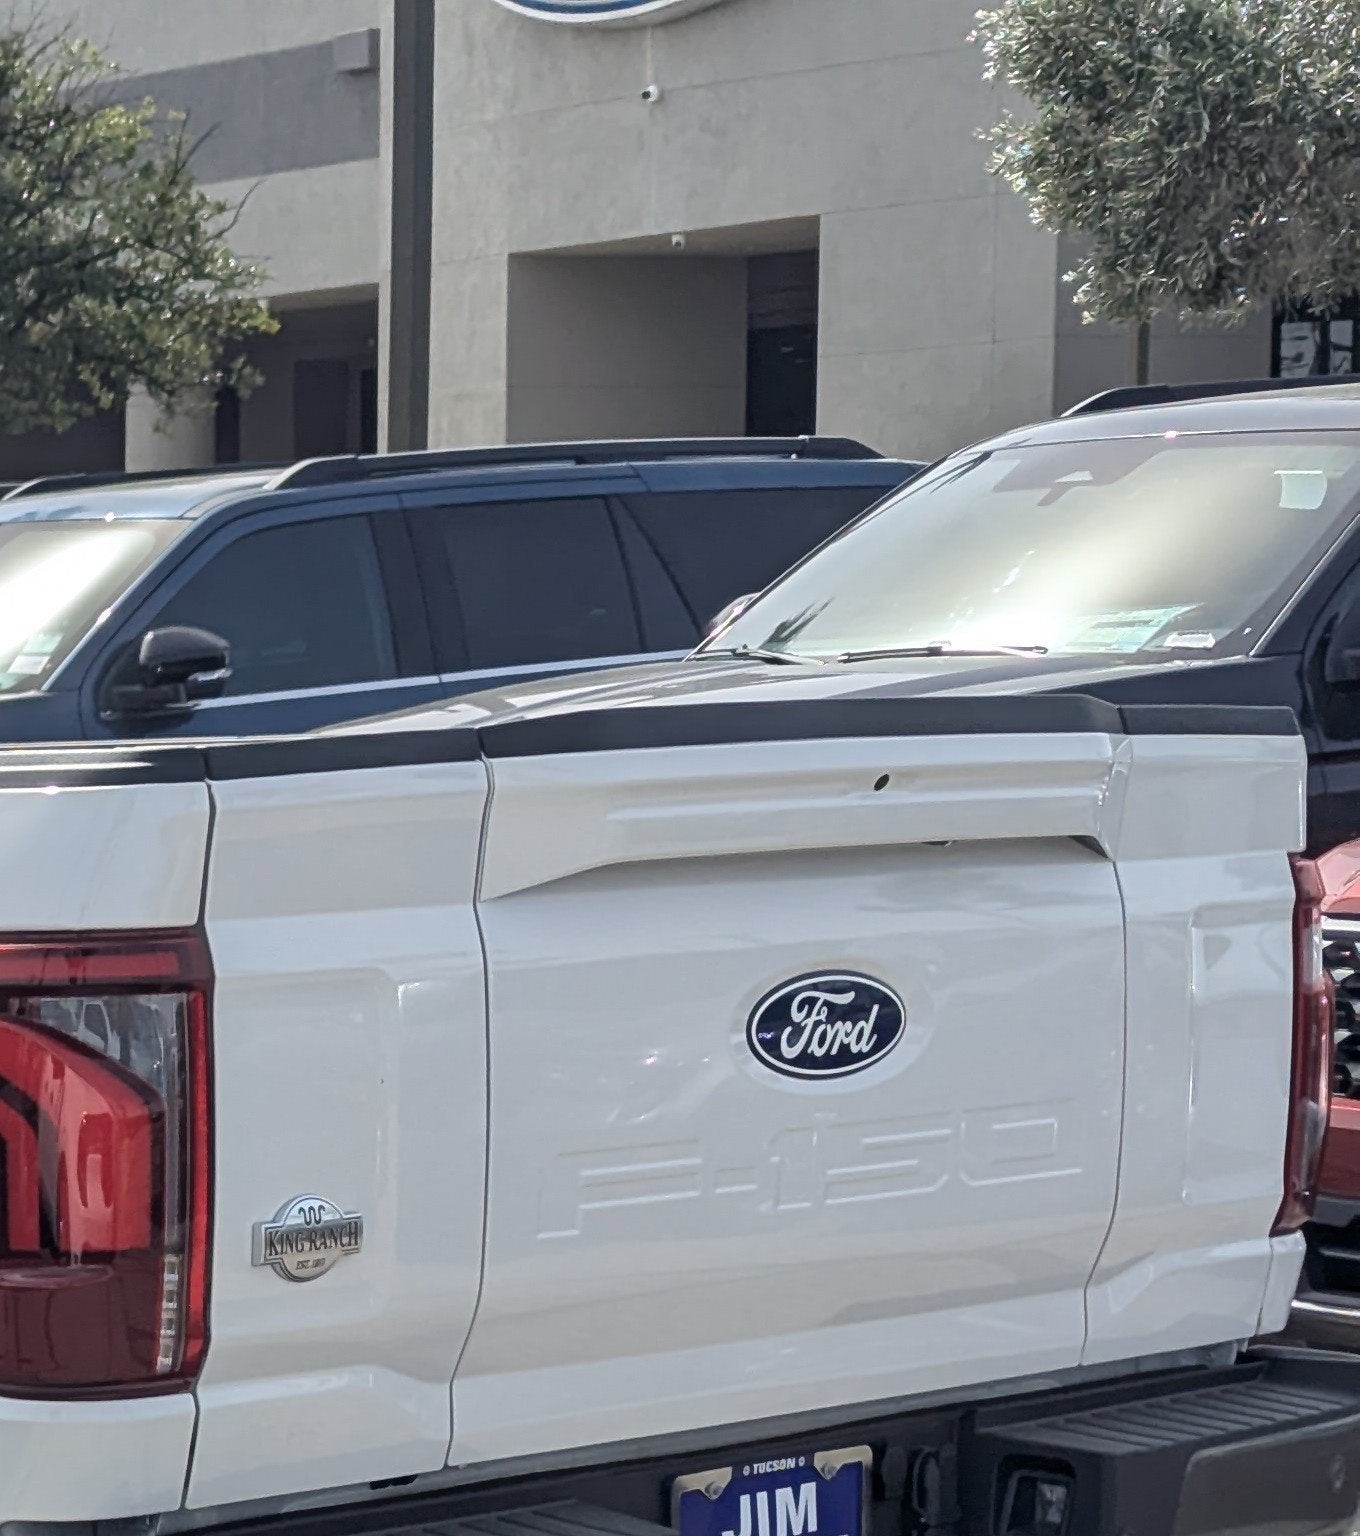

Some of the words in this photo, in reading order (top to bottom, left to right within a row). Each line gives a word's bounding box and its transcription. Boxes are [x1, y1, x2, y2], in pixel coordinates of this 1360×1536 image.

[780, 989, 880, 1060] Ford
[536, 1098, 1083, 1240] F-150
[268, 1230, 305, 1257] KING
[309, 1220, 359, 1251] RANCH
[752, 1457, 796, 1475] TUCSON
